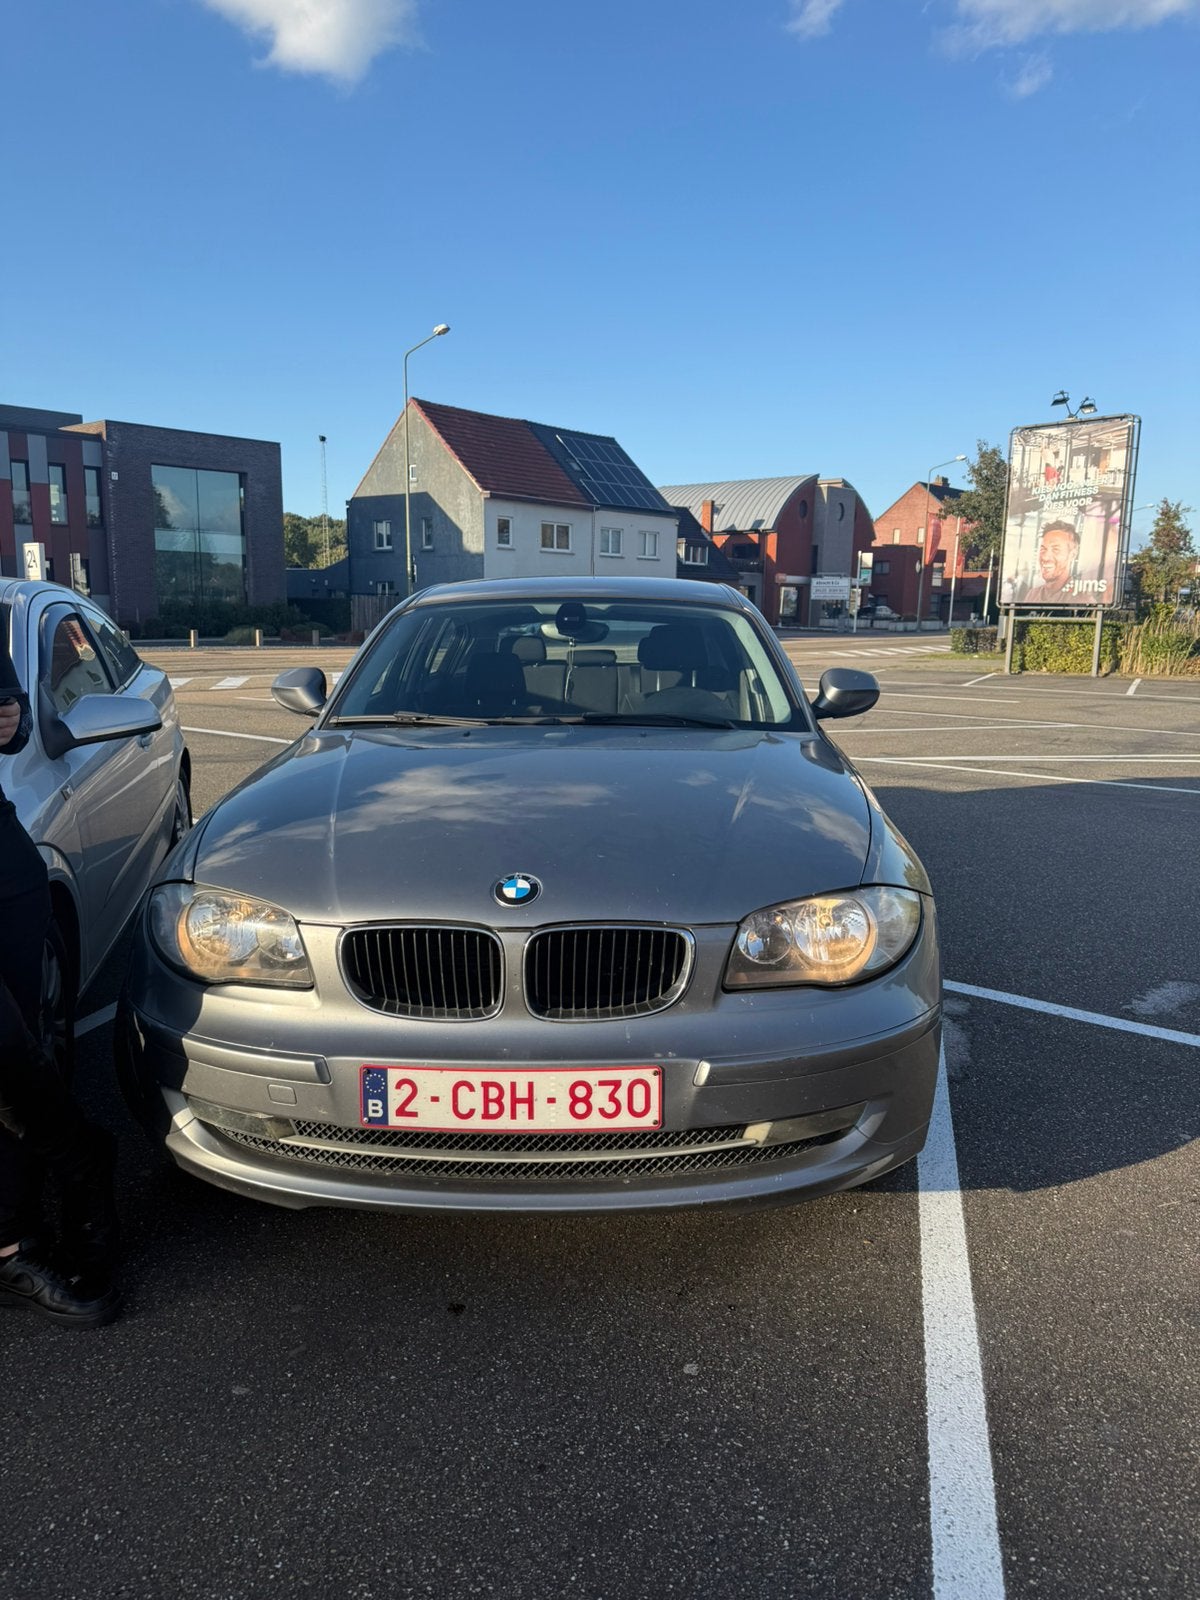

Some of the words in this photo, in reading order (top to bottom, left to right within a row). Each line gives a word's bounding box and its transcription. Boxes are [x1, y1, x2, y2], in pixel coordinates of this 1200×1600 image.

[1031, 485, 1052, 496] KIES
[1038, 492, 1060, 503] DAN
[1060, 485, 1099, 500] FITNESS
[1043, 500, 1065, 511] KIES
[1066, 496, 1093, 508] VOOR
[367, 1099, 384, 1118] B
[395, 1078, 652, 1121] 2-CBH-830
